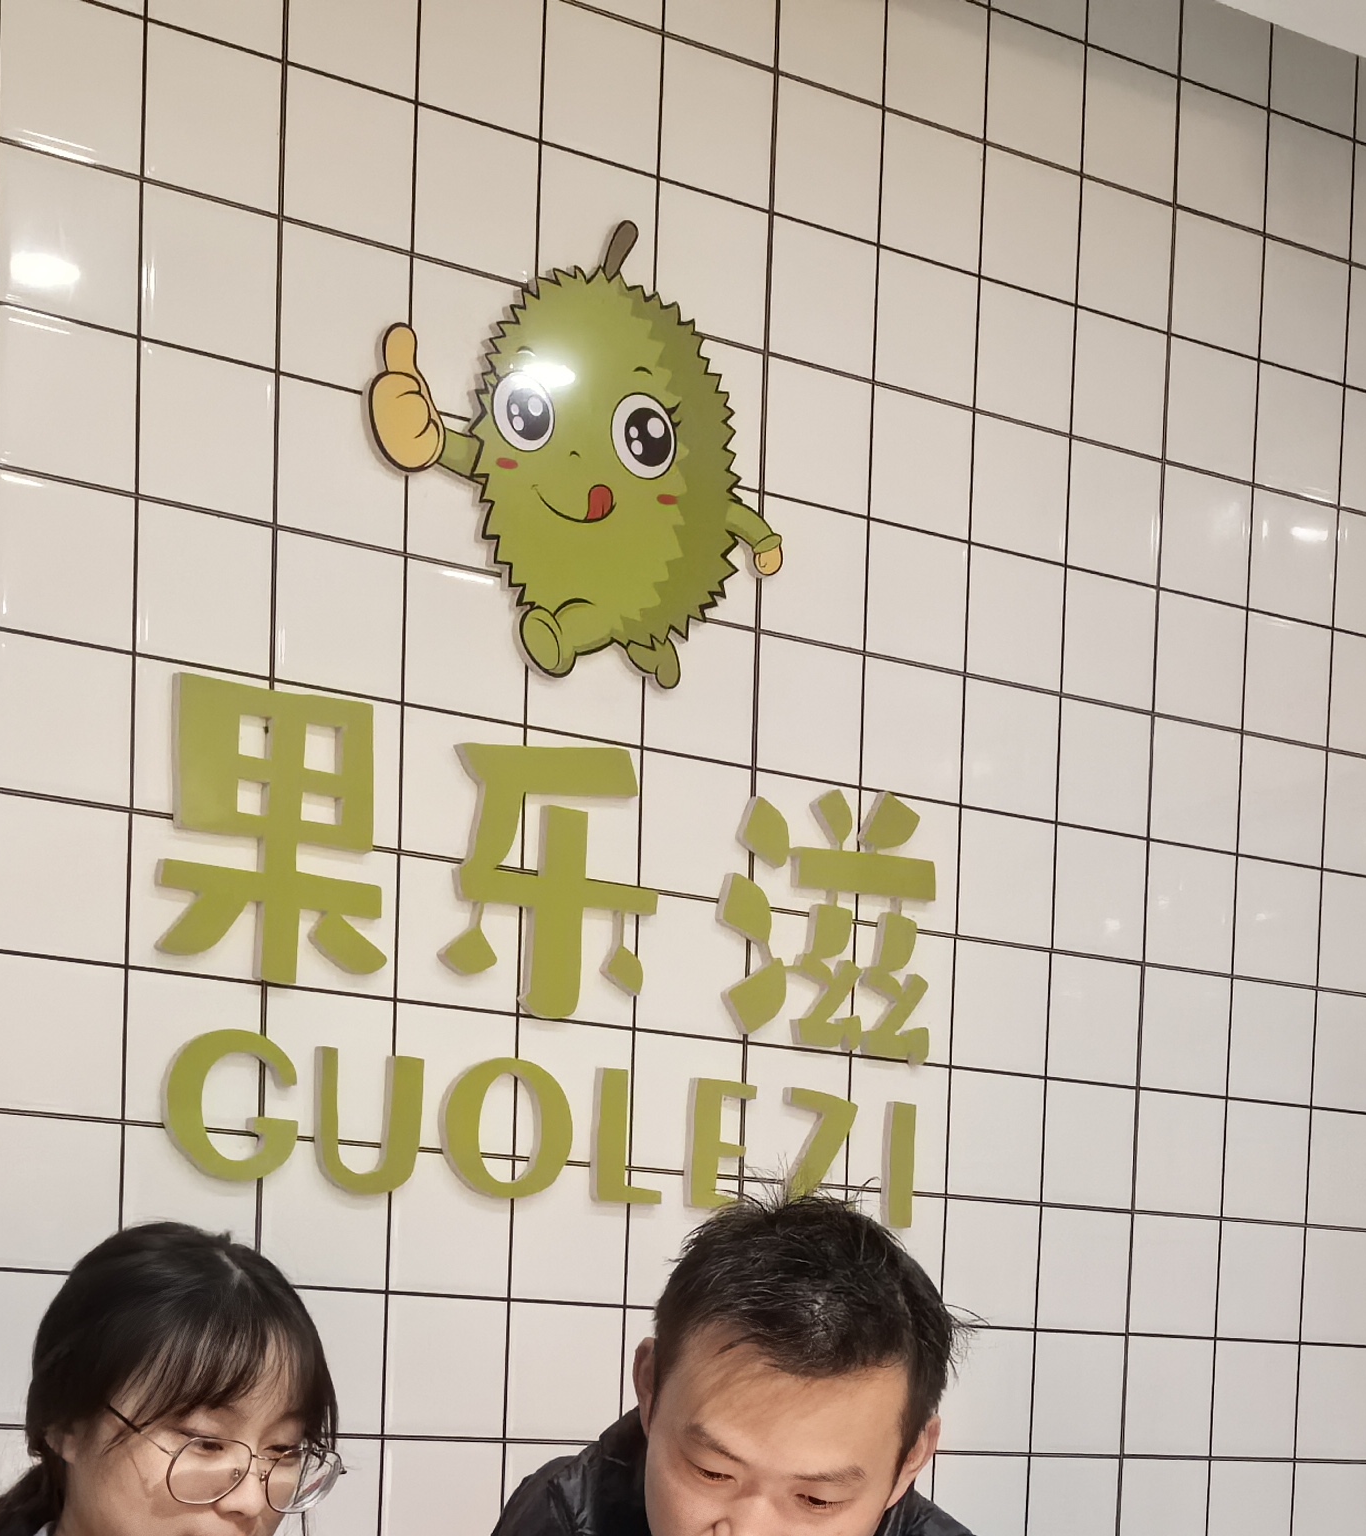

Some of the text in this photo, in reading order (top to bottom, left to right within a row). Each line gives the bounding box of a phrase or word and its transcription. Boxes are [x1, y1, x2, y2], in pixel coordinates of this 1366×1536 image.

[153, 671, 937, 1066] 果乐滋
[161, 1028, 918, 1230] GUOLEZI
